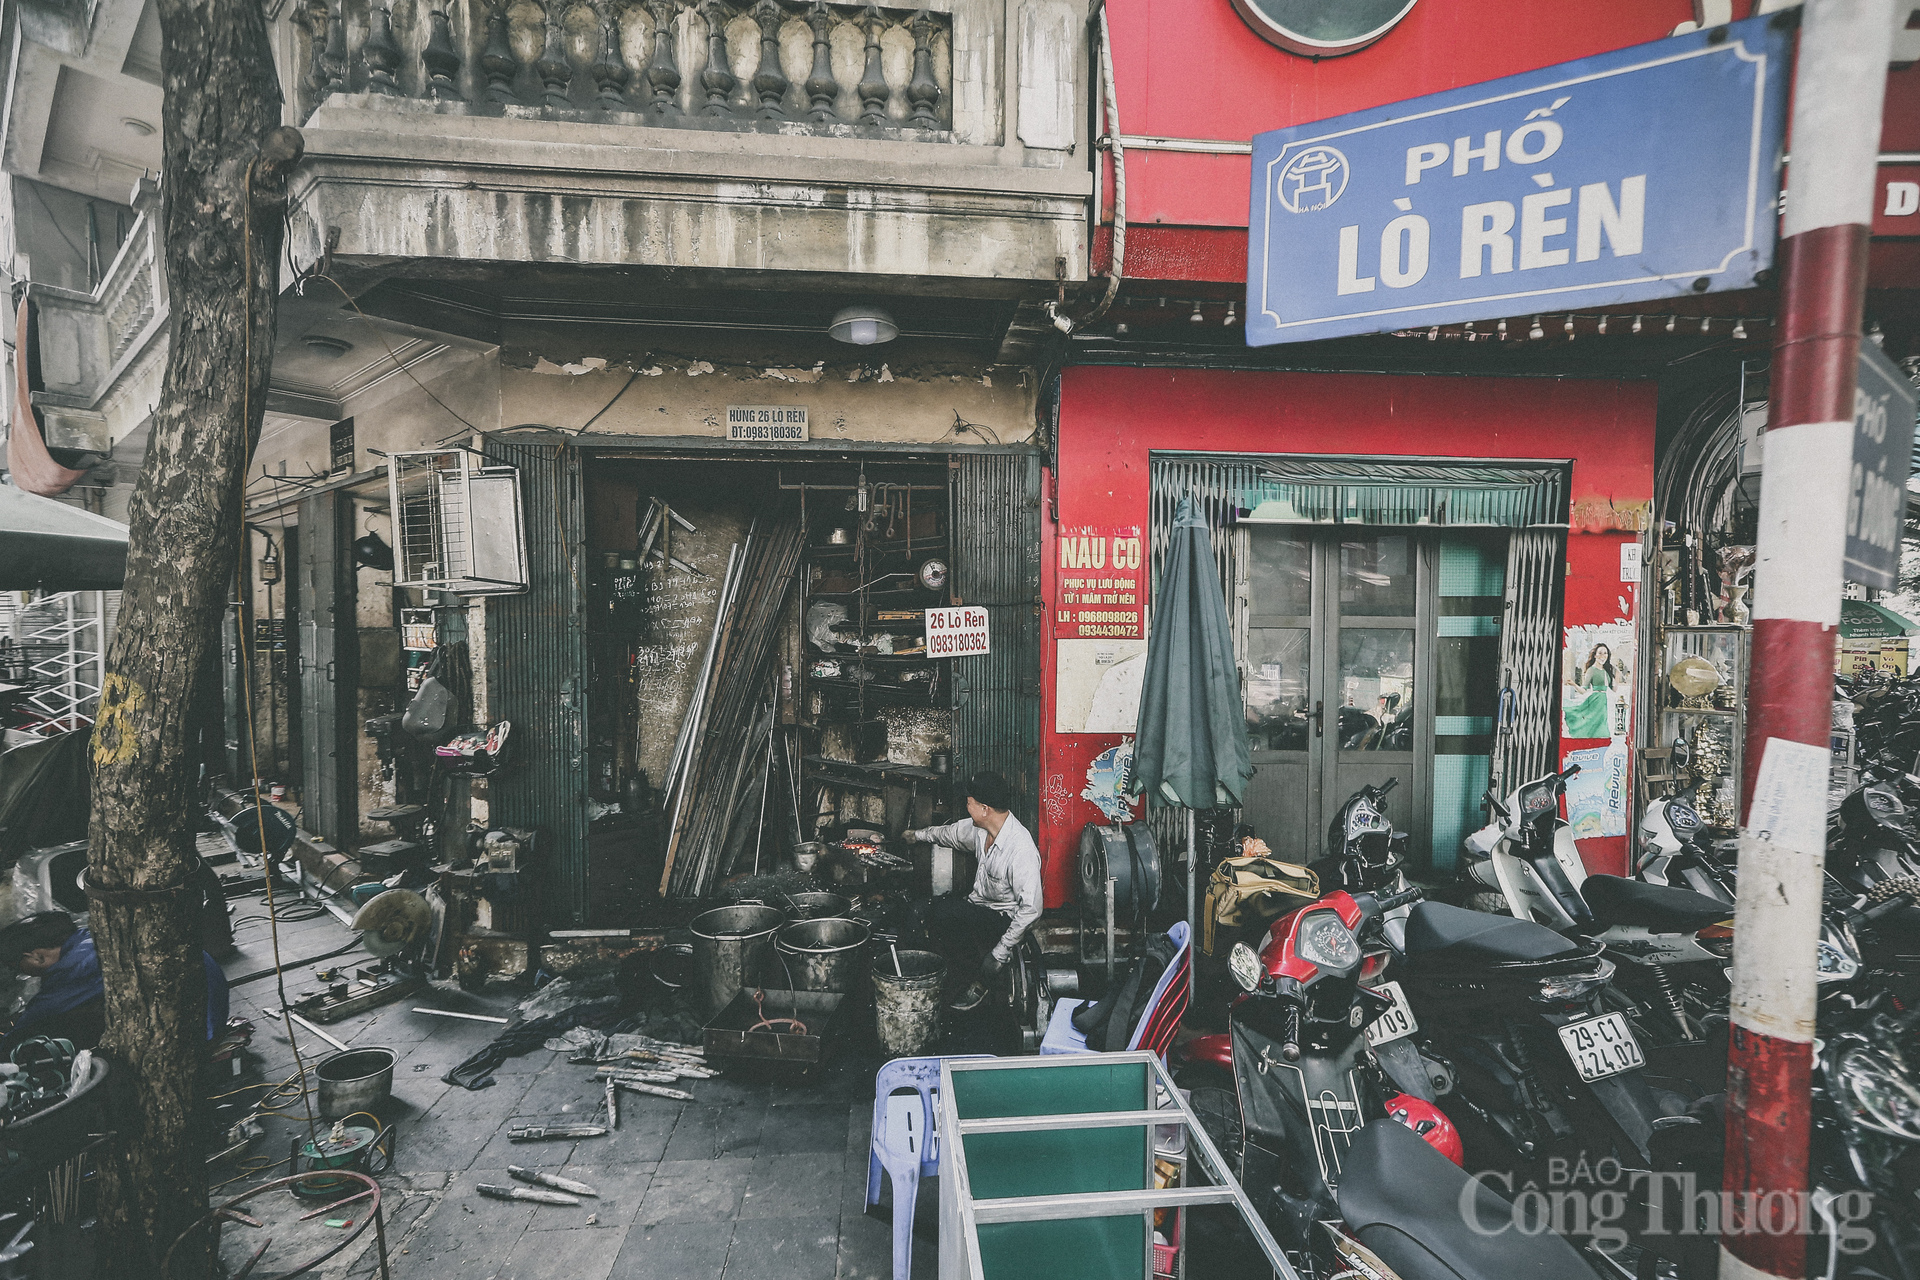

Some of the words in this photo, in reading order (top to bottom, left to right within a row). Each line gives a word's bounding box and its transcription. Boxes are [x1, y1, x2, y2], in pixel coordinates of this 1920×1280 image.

[1405, 96, 1572, 186] PHỐ
[1337, 197, 1431, 296] LÒ
[1459, 172, 1647, 280] RÈN
[729, 407, 755, 422] HÙNG
[758, 410, 769, 422] 26
[772, 407, 783, 422] LÒ
[786, 407, 805, 423] RÈN
[732, 426, 802, 438] ĐT:0983180362
[1064, 578, 1085, 591] PHỤC
[1086, 578, 1097, 591] VỤ
[1114, 577, 1136, 591] ĐỘNG
[1063, 591, 1075, 604] TỪ
[1075, 594, 1080, 604] 1
[1081, 592, 1102, 604] MÂM
[1103, 590, 1118, 605] TRỞ
[1119, 592, 1136, 605] NÊN
[930, 612, 945, 629] 26
[948, 611, 961, 628] Lò
[964, 610, 985, 627] Rèn
[1078, 611, 1138, 623] 0968098026
[1842, 615, 1883, 625] Food
[1078, 624, 1139, 637] 0934430472
[930, 632, 986, 653] 0983180362
[1572, 753, 1599, 761] evive
[1609, 757, 1621, 809] Revive
[1567, 1011, 1589, 1021] HONDA
[1570, 1018, 1622, 1051] 29-C1
[1578, 1041, 1641, 1076] 424.02
